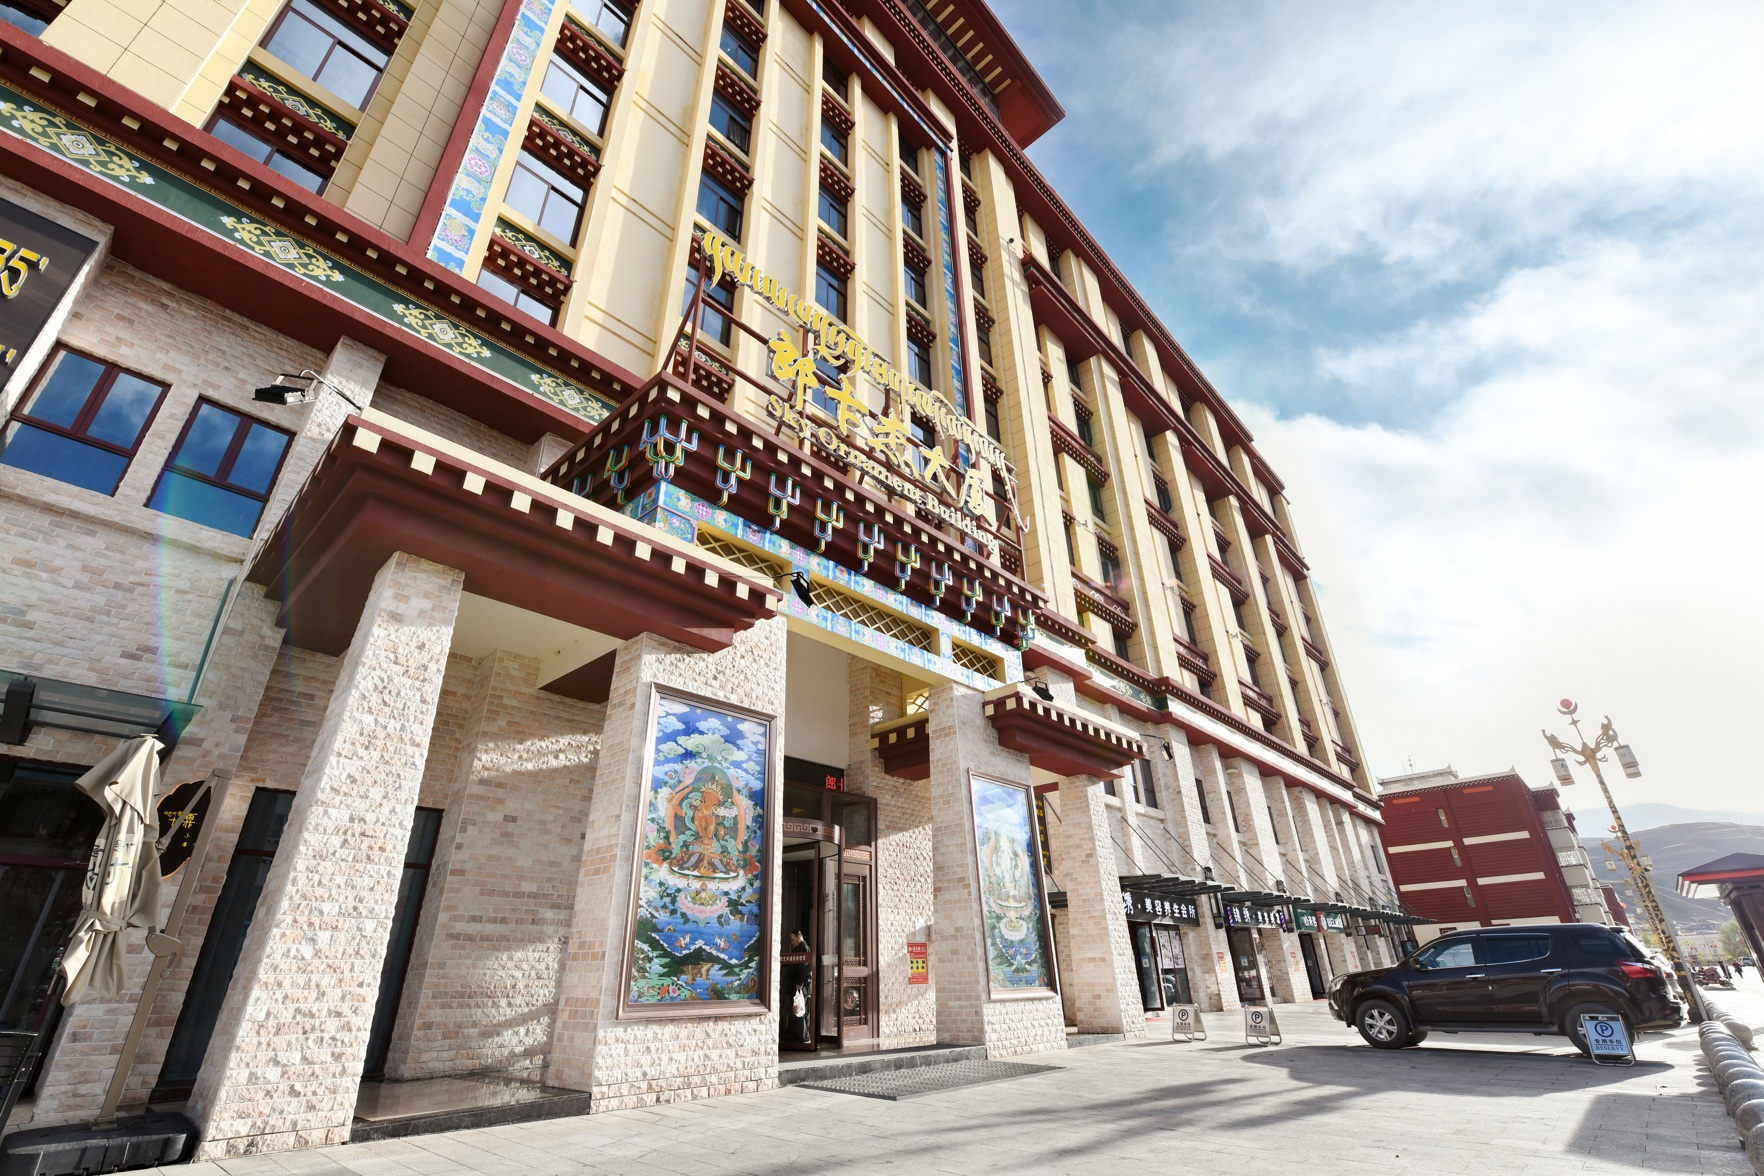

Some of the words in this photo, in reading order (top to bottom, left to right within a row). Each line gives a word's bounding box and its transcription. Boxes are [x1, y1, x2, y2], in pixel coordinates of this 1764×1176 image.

[767, 395, 811, 439] Sky
[818, 425, 924, 504] Ornament
[925, 491, 1000, 554] Building
[768, 328, 995, 528] 郎卡杰大厦
[1599, 1024, 1609, 1034] P
